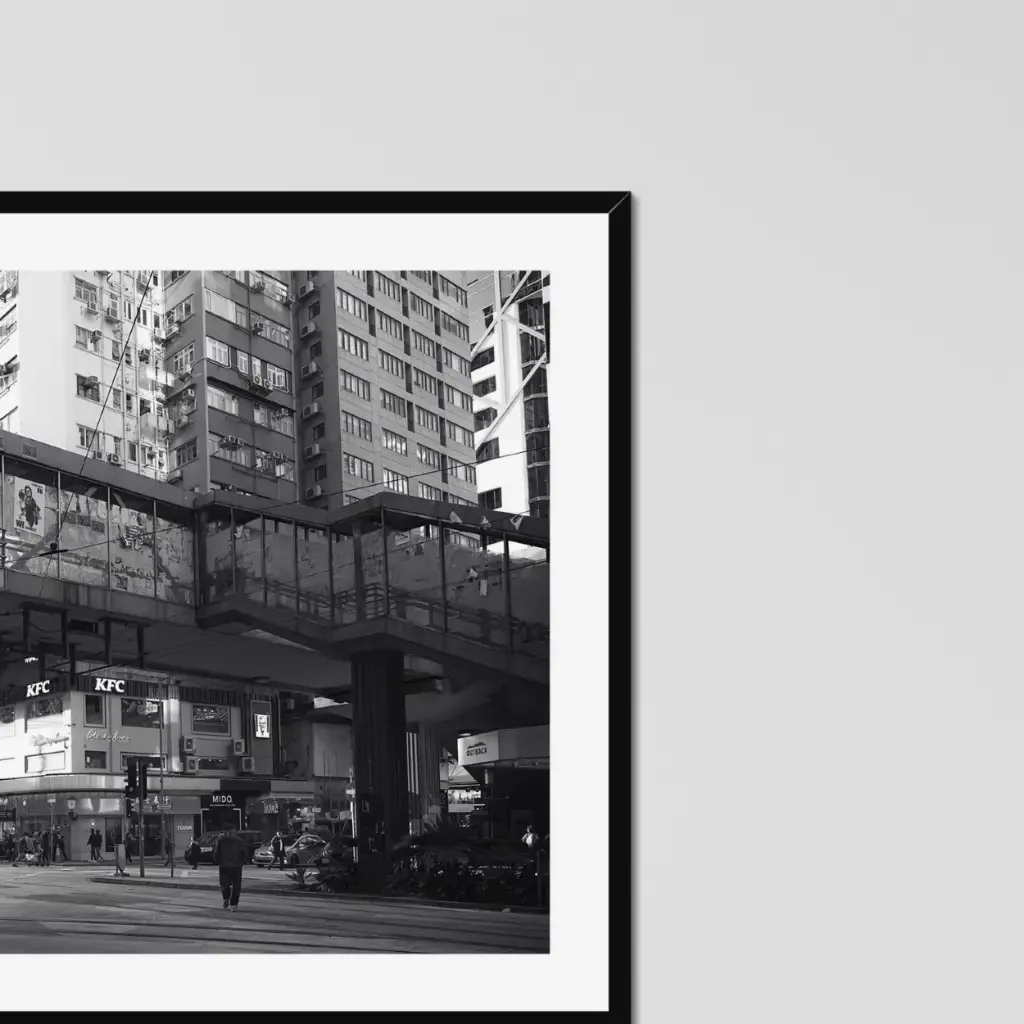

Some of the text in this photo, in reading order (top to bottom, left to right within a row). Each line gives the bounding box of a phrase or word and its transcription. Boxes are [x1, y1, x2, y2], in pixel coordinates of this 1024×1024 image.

[26, 679, 50, 698] KFC
[94, 677, 125, 693] KFC
[466, 747, 487, 756] OUTBACK
[212, 795, 233, 803] MIDO
